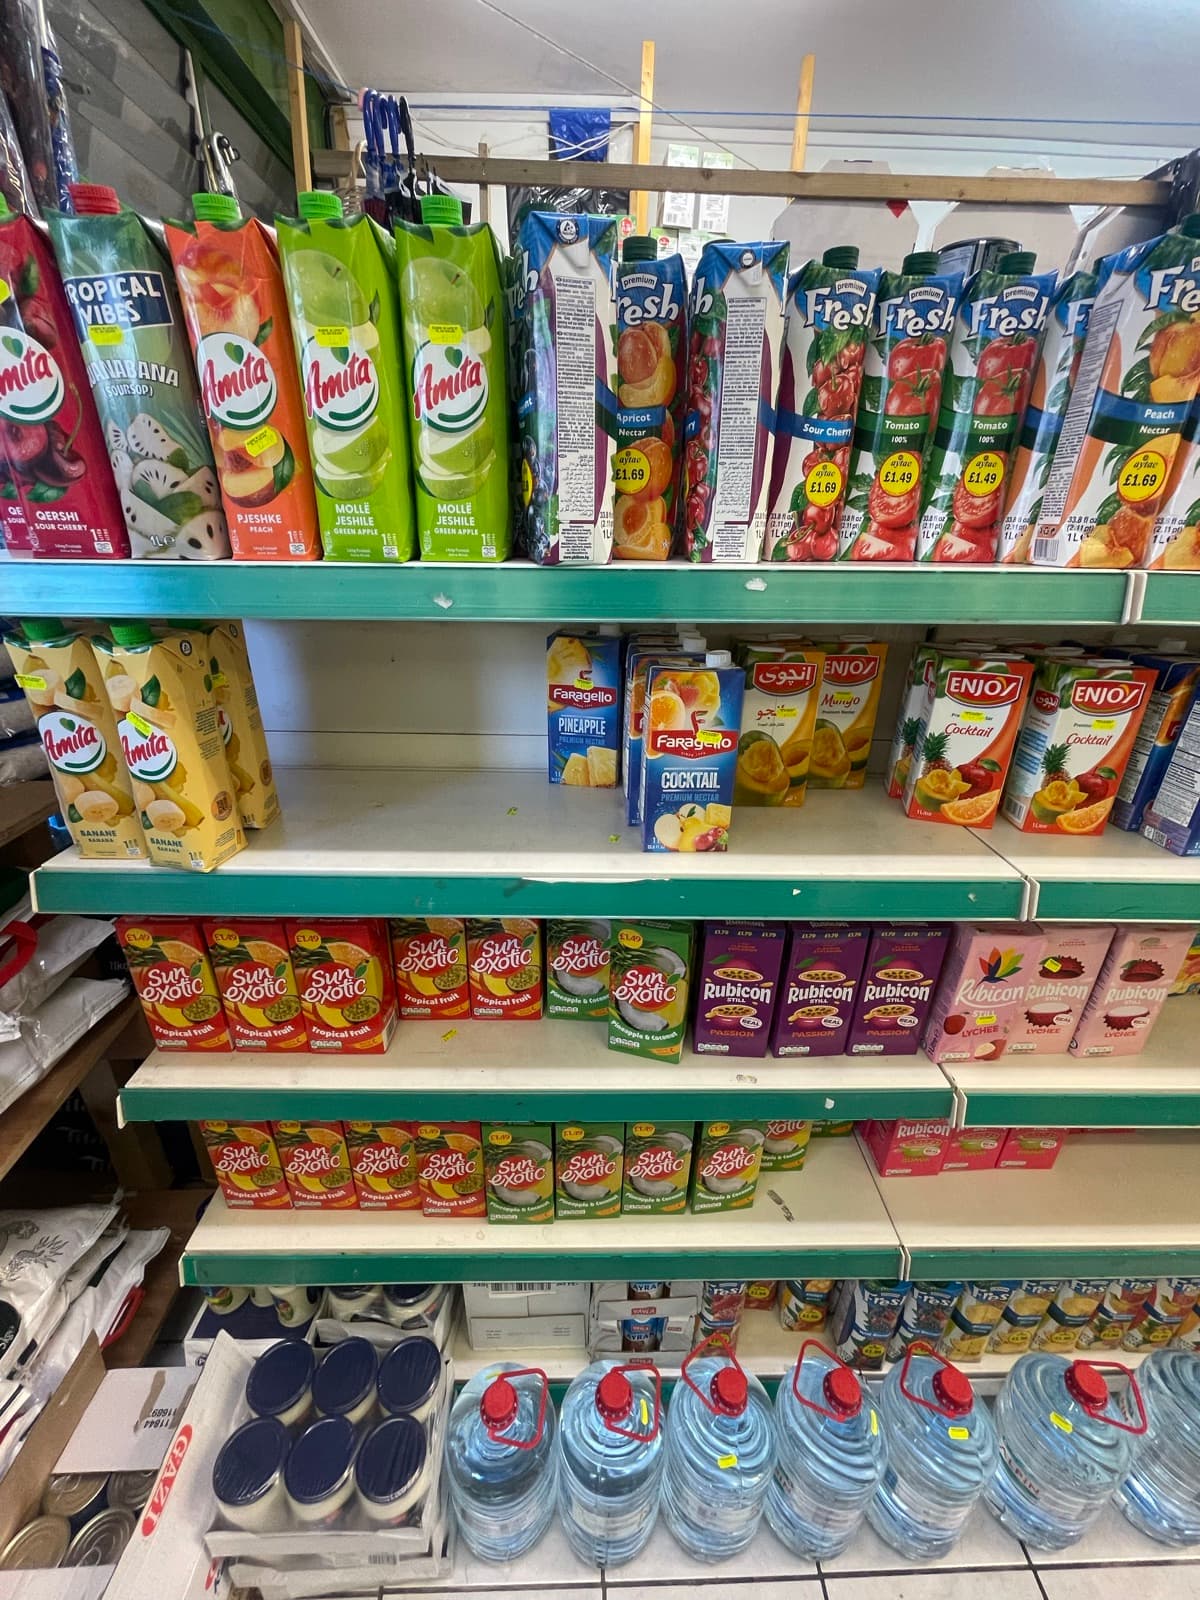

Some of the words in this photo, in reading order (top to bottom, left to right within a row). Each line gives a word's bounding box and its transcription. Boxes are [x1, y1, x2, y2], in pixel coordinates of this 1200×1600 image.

[623, 275, 655, 288] premium
[836, 281, 866, 292] premium
[1143, 265, 1200, 312] Fre
[910, 290, 942, 301] premium
[1004, 287, 1036, 300] premium
[617, 283, 679, 325] resh
[80, 299, 140, 327] VIBES
[877, 295, 956, 337] Fresh
[967, 298, 1049, 338] Fresh
[0, 350, 52, 399] mita
[202, 354, 269, 420] Amita
[305, 355, 373, 420] Amita
[414, 354, 483, 420] Amita
[617, 412, 651, 425] Apricot
[1144, 408, 1175, 420] Peach
[618, 427, 646, 438] Nectar
[803, 423, 825, 434] Sour
[885, 420, 920, 430] Tomato
[973, 420, 1008, 430] Tomato
[1139, 425, 1170, 436] Nectar
[891, 435, 908, 444] 100%
[978, 436, 995, 444] 100%
[616, 468, 645, 481] £1.69
[883, 471, 912, 484] £1.49
[968, 472, 997, 484] £1.49
[1122, 474, 1157, 488] £1.69
[810, 481, 837, 494] £1.69
[36, 510, 80, 522] QERSHI
[335, 502, 371, 514] MOLLË
[437, 502, 472, 514] MOLLË
[236, 513, 282, 524] PJESHKE
[335, 516, 375, 527] JESHILE
[436, 515, 475, 527] JESHILE
[57, 523, 88, 531] CHERRY
[249, 526, 273, 534] PEACH
[333, 527, 355, 535] GREEN
[357, 528, 378, 536] APPLE
[434, 527, 455, 536] GREEN
[456, 528, 478, 536] APPLE
[823, 659, 876, 675] ENJOY
[950, 676, 1016, 697] ENJOY
[1074, 685, 1141, 704] ENJOY
[553, 688, 612, 703] Faragello
[558, 717, 606, 735] PINEAPPLE
[944, 722, 994, 738] Cocktail
[43, 725, 98, 761] Amita
[1065, 732, 1112, 747] Cocktail
[121, 733, 169, 767] Amita
[661, 771, 720, 789] COCKTAIL
[661, 793, 693, 801] PREMIUM
[694, 793, 719, 801] NECTAR
[619, 931, 642, 943] £1.49
[408, 936, 447, 958] Sun
[481, 936, 519, 958] Sun
[560, 938, 600, 958] Sun
[398, 948, 459, 973] exotic
[471, 948, 532, 973] exotic
[551, 949, 610, 973] exotic
[148, 966, 189, 987] Sun
[232, 966, 272, 987] Sun
[311, 966, 352, 987] Sun
[624, 969, 665, 990] Sun
[140, 977, 204, 1004] exotic
[223, 976, 287, 1004] exotic
[301, 977, 367, 1004] exotic
[613, 982, 677, 1005] exotic
[704, 983, 771, 1004] Rubicon
[787, 984, 853, 1004] Rubicon
[864, 983, 930, 1003] Rubicon
[955, 979, 1024, 1008] Rubicon
[1025, 983, 1089, 1001] Rubicon
[1104, 987, 1168, 1005] Rubicon
[404, 993, 440, 1005] Tropical
[440, 993, 460, 1003] Fruit
[476, 994, 511, 1005] Tropical
[511, 993, 532, 1004] Fruit
[741, 1018, 760, 1027] REAL
[823, 1018, 842, 1026] REAL
[899, 1017, 917, 1026] REAL
[155, 1025, 193, 1037] Tropical
[193, 1025, 215, 1036] Fruit
[236, 1025, 273, 1037] Tropical
[274, 1025, 295, 1036] Fruit
[312, 1026, 349, 1038] Tropical
[349, 1025, 371, 1036] Fruit
[710, 1029, 754, 1038] PASSION
[792, 1029, 836, 1038] PASSION
[866, 1029, 910, 1037] PASSION
[961, 1025, 999, 1038] LYCHEE
[897, 1124, 950, 1139] Rubicon
[222, 1145, 255, 1161] Sun
[293, 1146, 327, 1163] Sun
[362, 1146, 396, 1163] Sun
[429, 1151, 463, 1168] Sun
[638, 1150, 673, 1167] Sun
[711, 1147, 745, 1165] Sun
[216, 1154, 271, 1174] exotic
[285, 1154, 340, 1175] exotic
[353, 1154, 409, 1175] exotic
[498, 1158, 532, 1174] Sun
[570, 1153, 604, 1170] Sun
[627, 1159, 684, 1178] exotic
[700, 1153, 756, 1178] exotic
[420, 1161, 476, 1181] exotic
[488, 1167, 546, 1187] exotic
[559, 1162, 616, 1182] exotic
